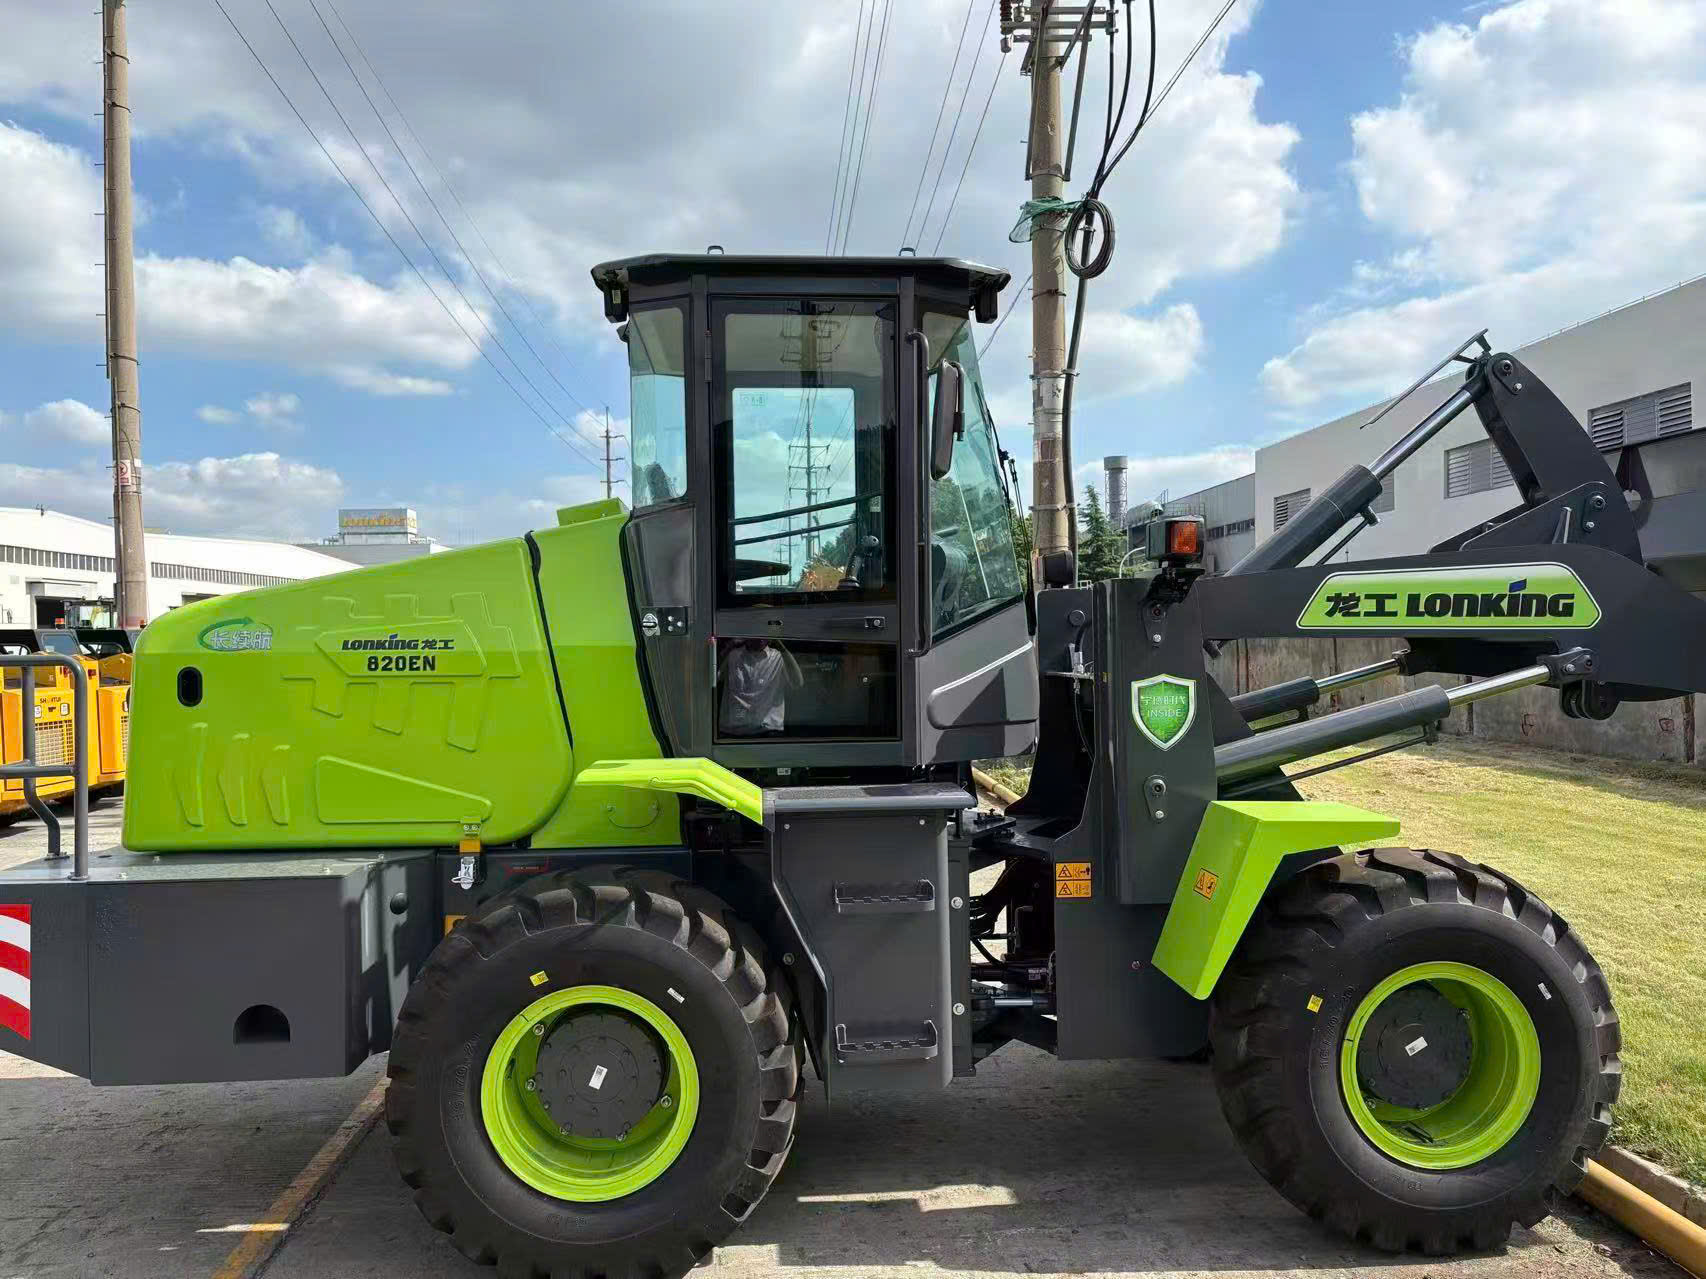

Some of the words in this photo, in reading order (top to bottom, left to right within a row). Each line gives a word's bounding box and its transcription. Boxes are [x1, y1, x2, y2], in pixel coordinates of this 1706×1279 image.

[1325, 592, 1398, 617] 龙工
[210, 631, 272, 649] 长续航
[420, 639, 454, 650] 龙工
[368, 655, 436, 671] 820EN
[1147, 708, 1183, 718] INSIDE
